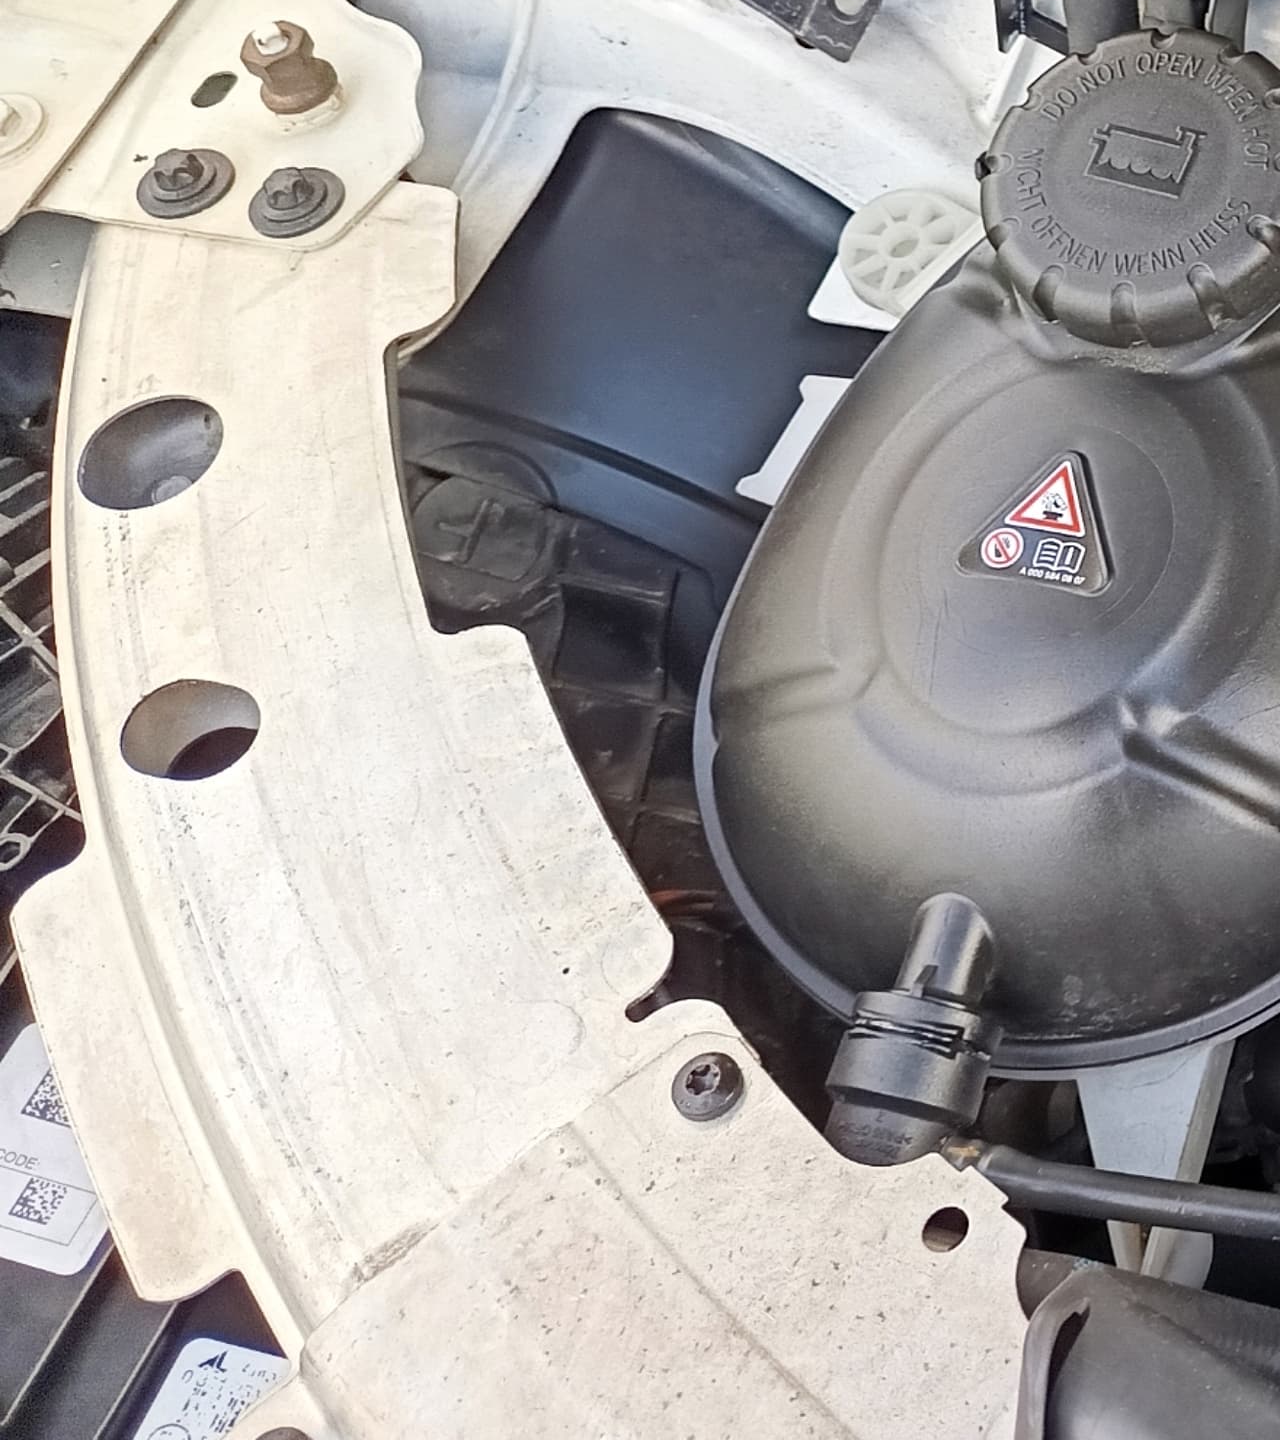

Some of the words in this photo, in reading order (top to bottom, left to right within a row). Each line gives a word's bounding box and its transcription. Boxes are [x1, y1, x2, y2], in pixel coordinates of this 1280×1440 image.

[1040, 88, 1078, 123] DO
[1080, 58, 1125, 94] NOT
[1135, 52, 1203, 79] OPEN
[1203, 63, 1261, 124] WHEN
[1113, 242, 1186, 276] WENN
